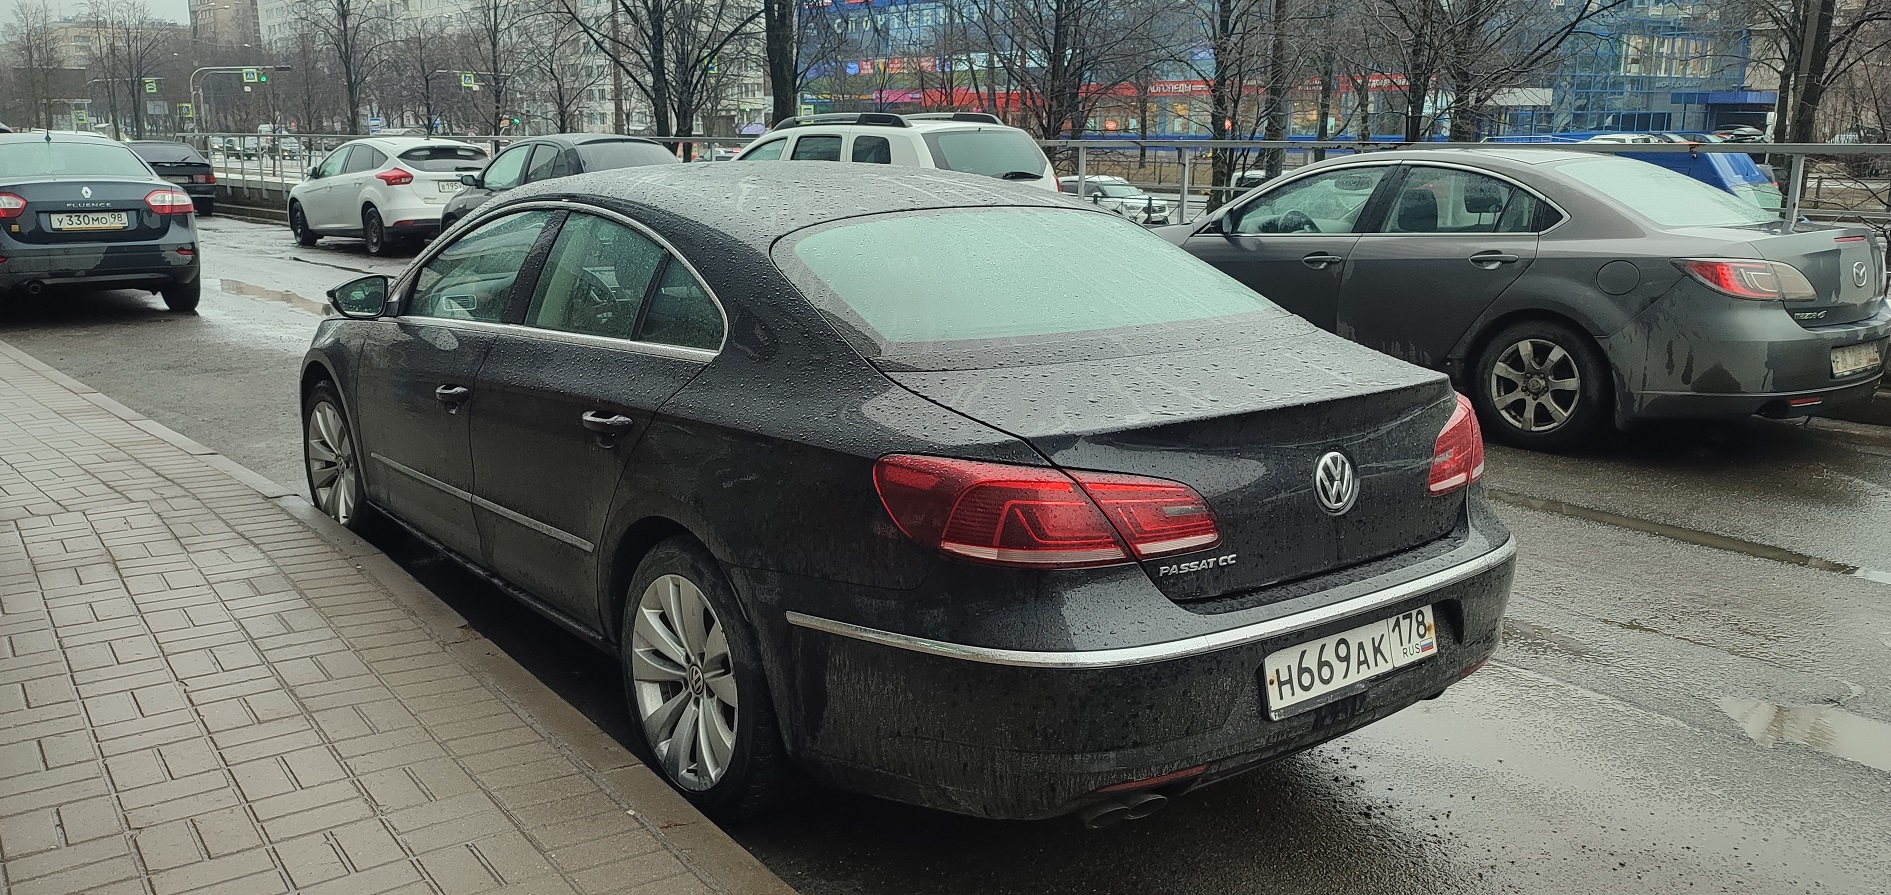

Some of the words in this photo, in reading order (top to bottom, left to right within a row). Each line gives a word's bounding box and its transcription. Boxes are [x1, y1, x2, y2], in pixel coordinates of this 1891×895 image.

[110, 213, 123, 222] 98
[1159, 557, 1217, 577] PASSAT
[1218, 553, 1237, 567] CC
[1391, 609, 1427, 647] 178
[1402, 643, 1421, 659] RUS
